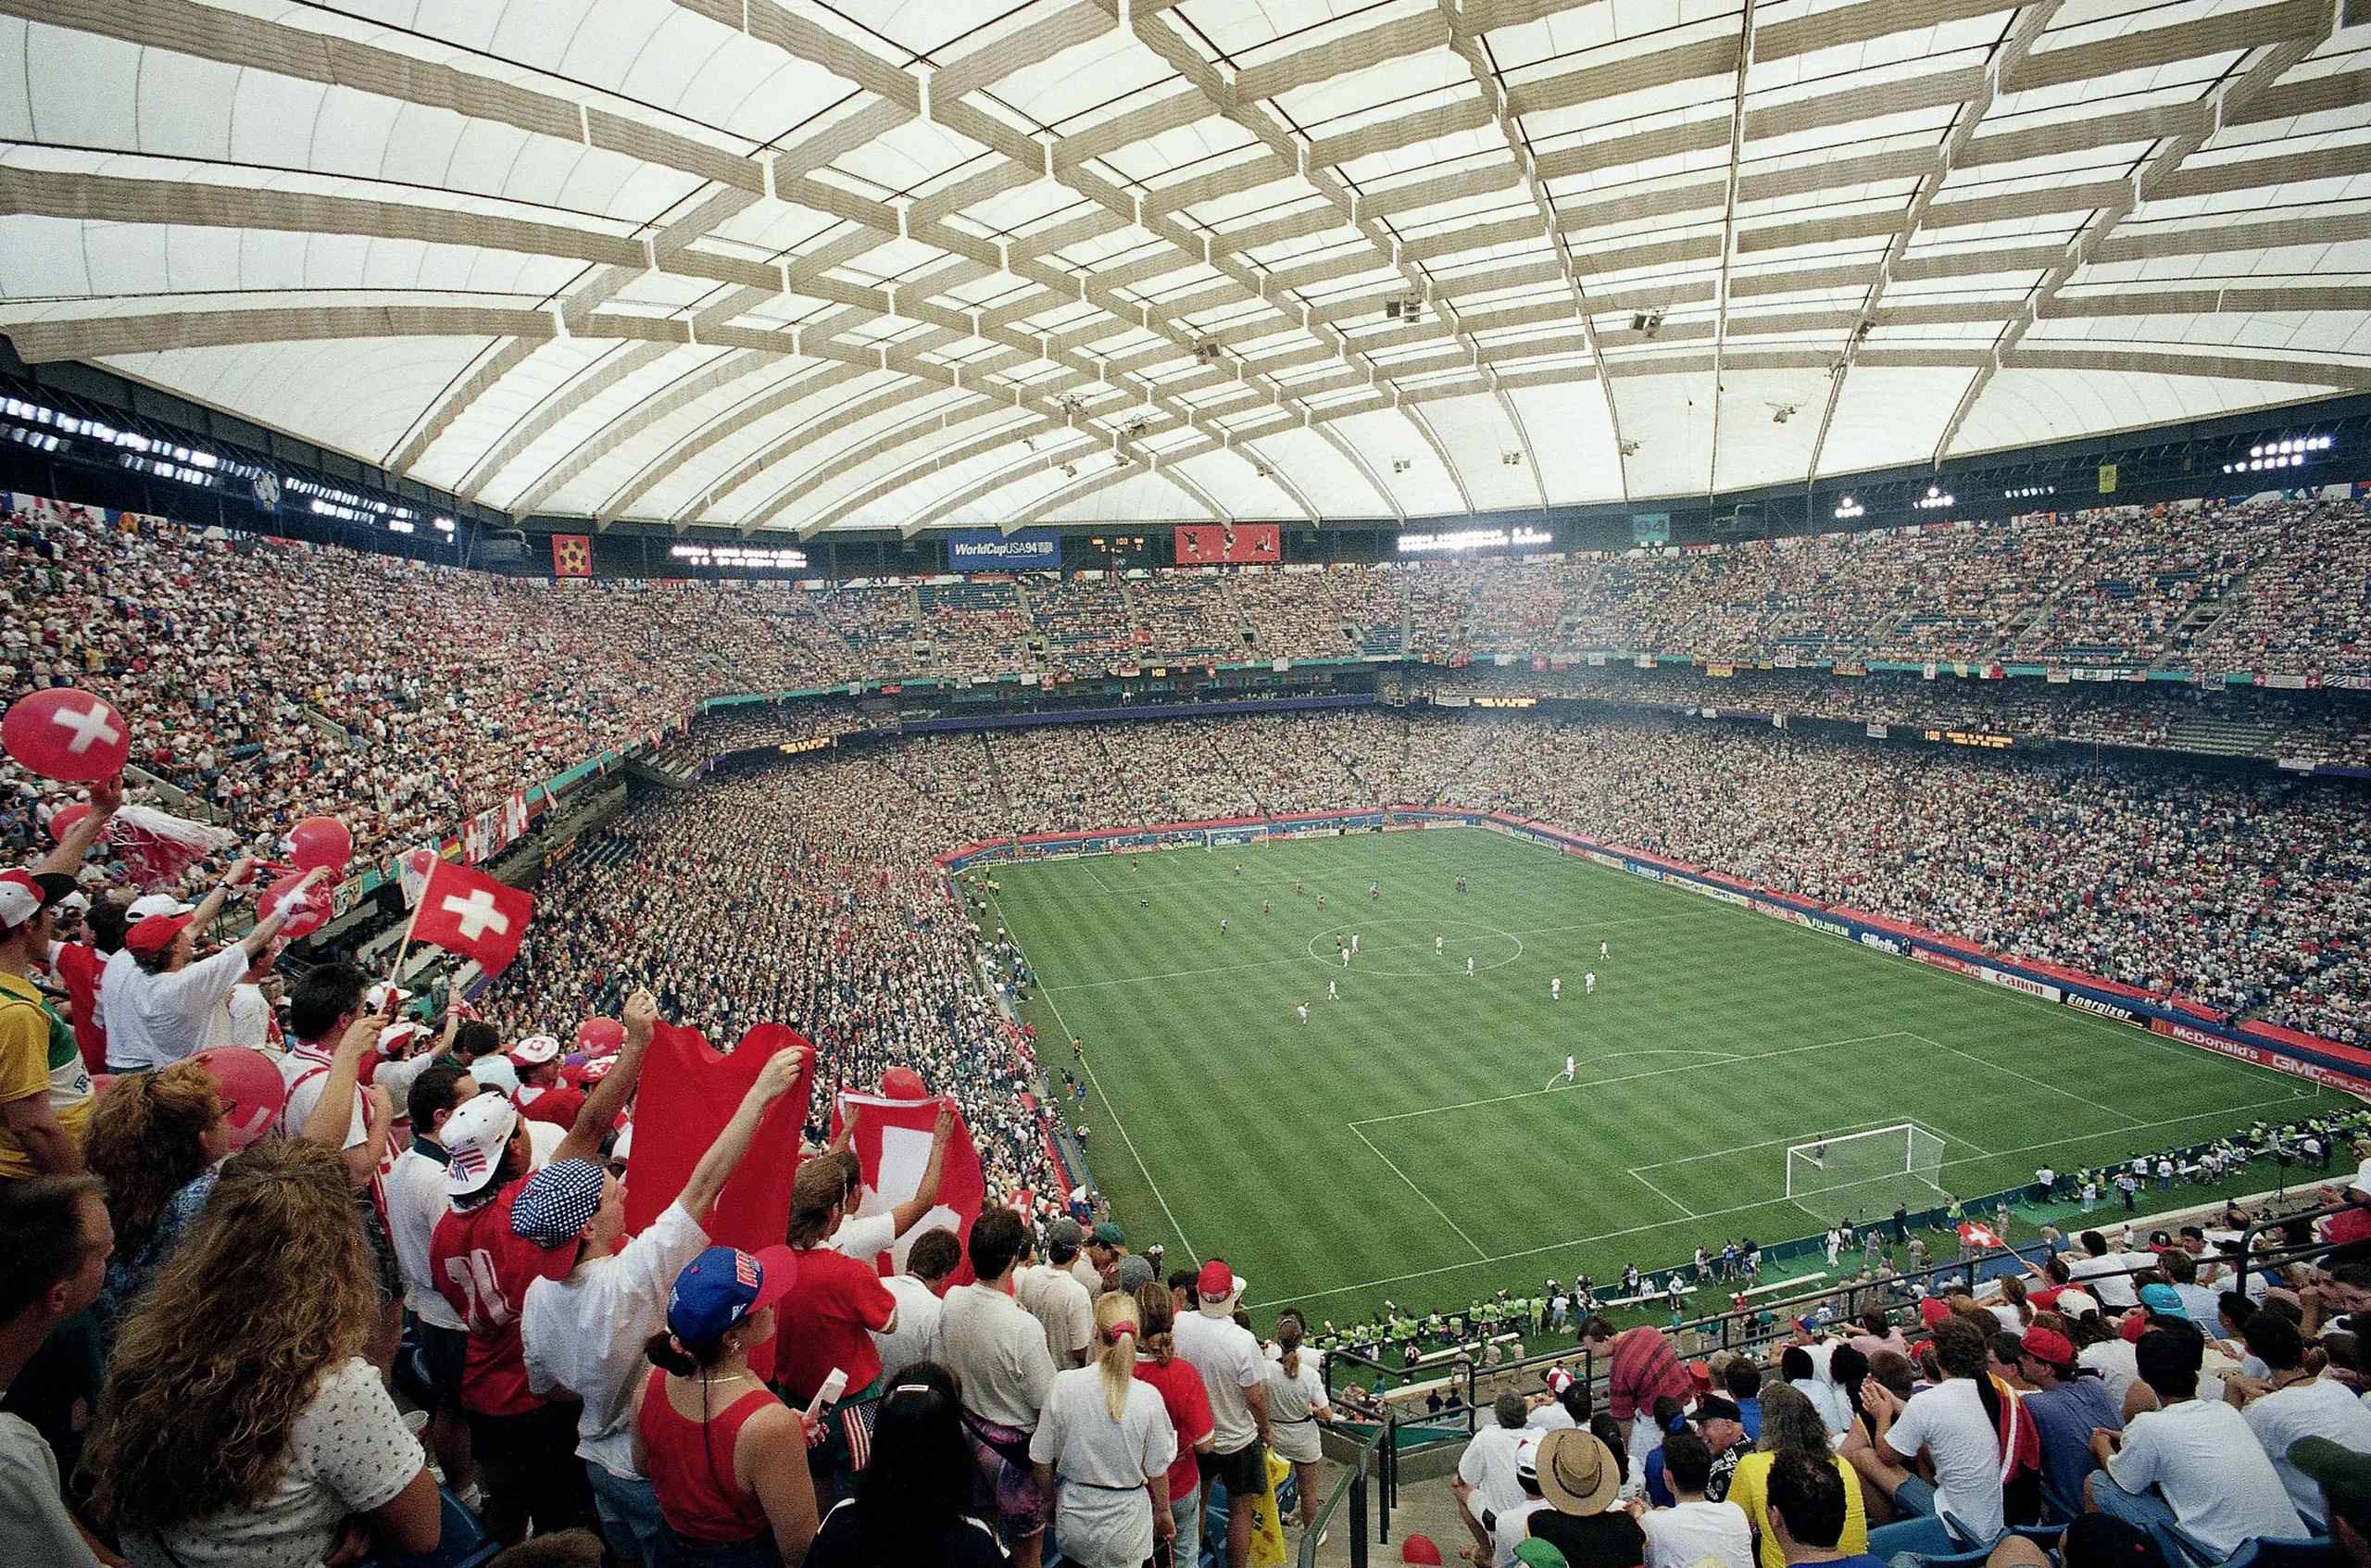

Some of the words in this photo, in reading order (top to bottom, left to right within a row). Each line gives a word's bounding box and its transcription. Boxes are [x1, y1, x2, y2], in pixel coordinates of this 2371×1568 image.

[1811, 917, 1850, 937] FUJIFILM
[1861, 932, 1899, 954] Gillette
[1912, 947, 1928, 960] JVC
[1961, 962, 1980, 976] JVC
[1995, 972, 2044, 996] Canon
[2066, 993, 2133, 1020] Energizer
[2173, 1025, 2260, 1060] McDonald's
[2271, 1054, 2327, 1078] GMC
